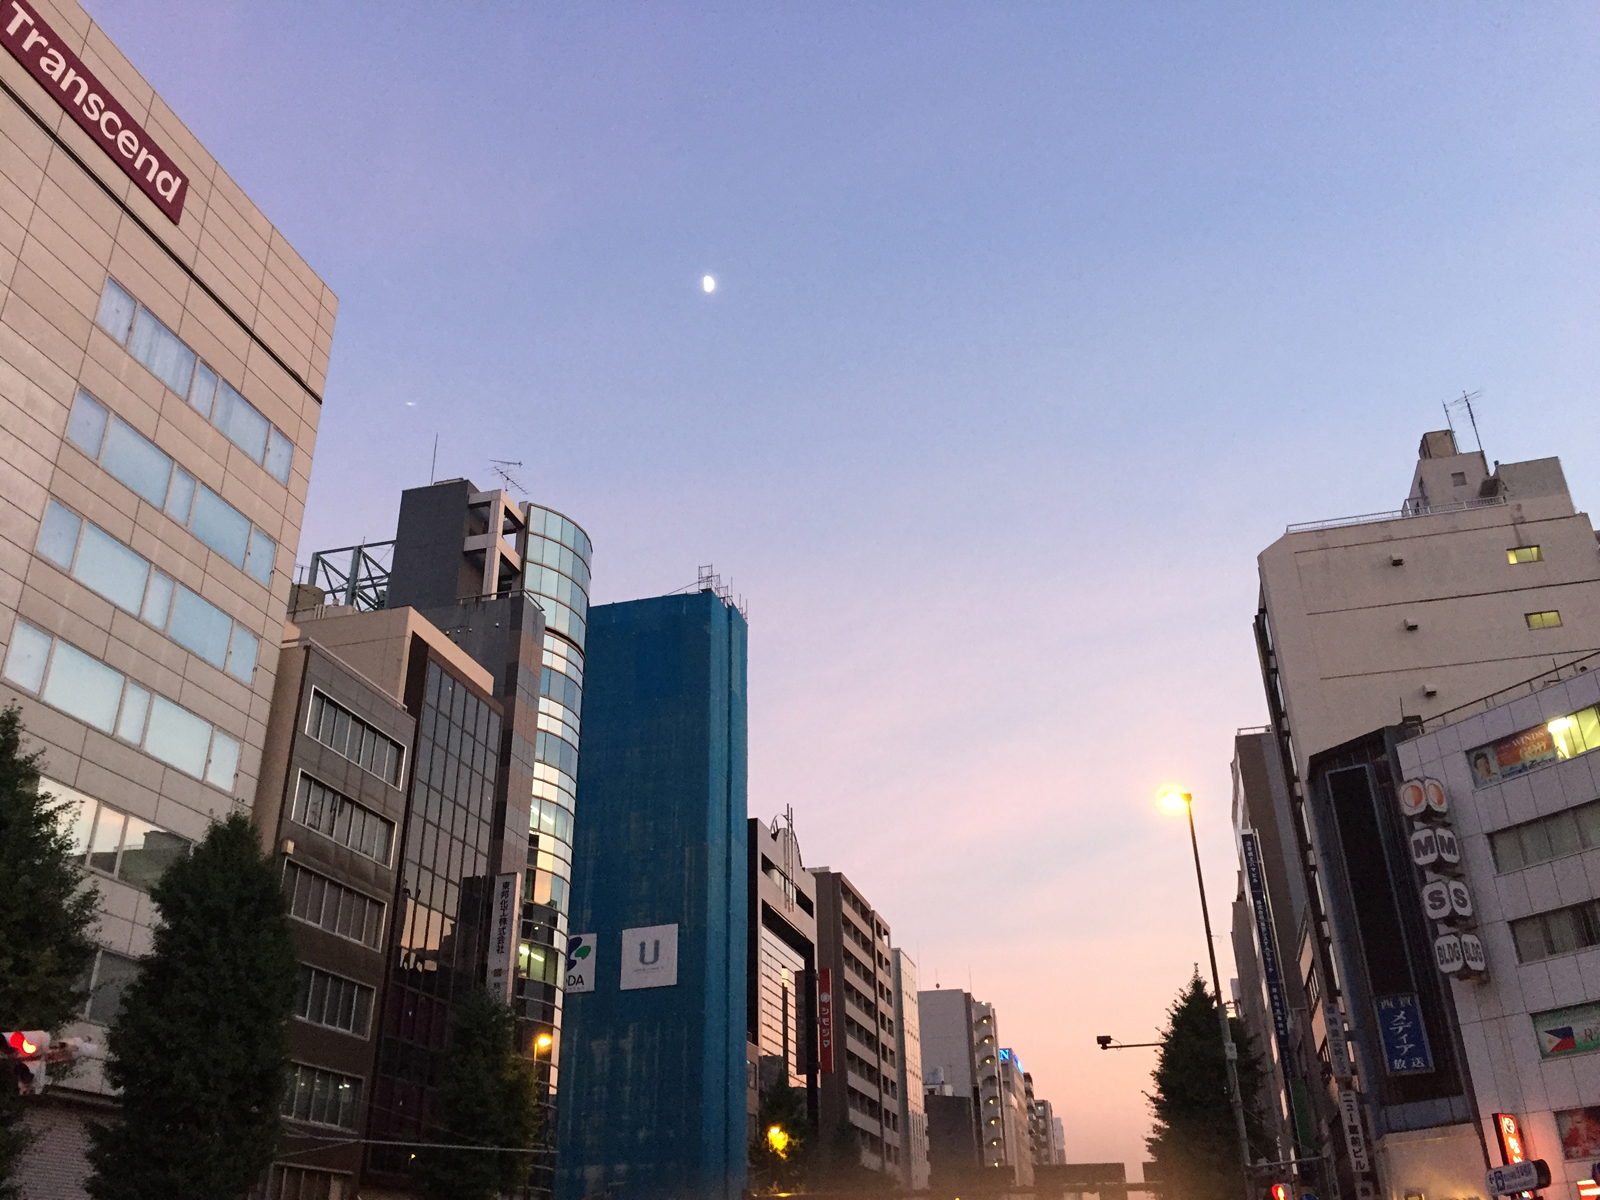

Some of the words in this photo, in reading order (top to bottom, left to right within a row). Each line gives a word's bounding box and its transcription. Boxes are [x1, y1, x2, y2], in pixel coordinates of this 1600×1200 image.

[6, 1, 182, 203] Transcend
[496, 881, 511, 954] 東邦化工株式会社
[1413, 835, 1437, 859] M
[1427, 889, 1447, 911] S
[1437, 941, 1461, 966] BLDG
[1437, 835, 1458, 860] M
[1452, 887, 1468, 910] S
[1463, 940, 1484, 965] BLDG
[566, 974, 584, 986] DA
[1389, 1010, 1415, 1056] メディア
[1394, 1057, 1426, 1070] 放送
